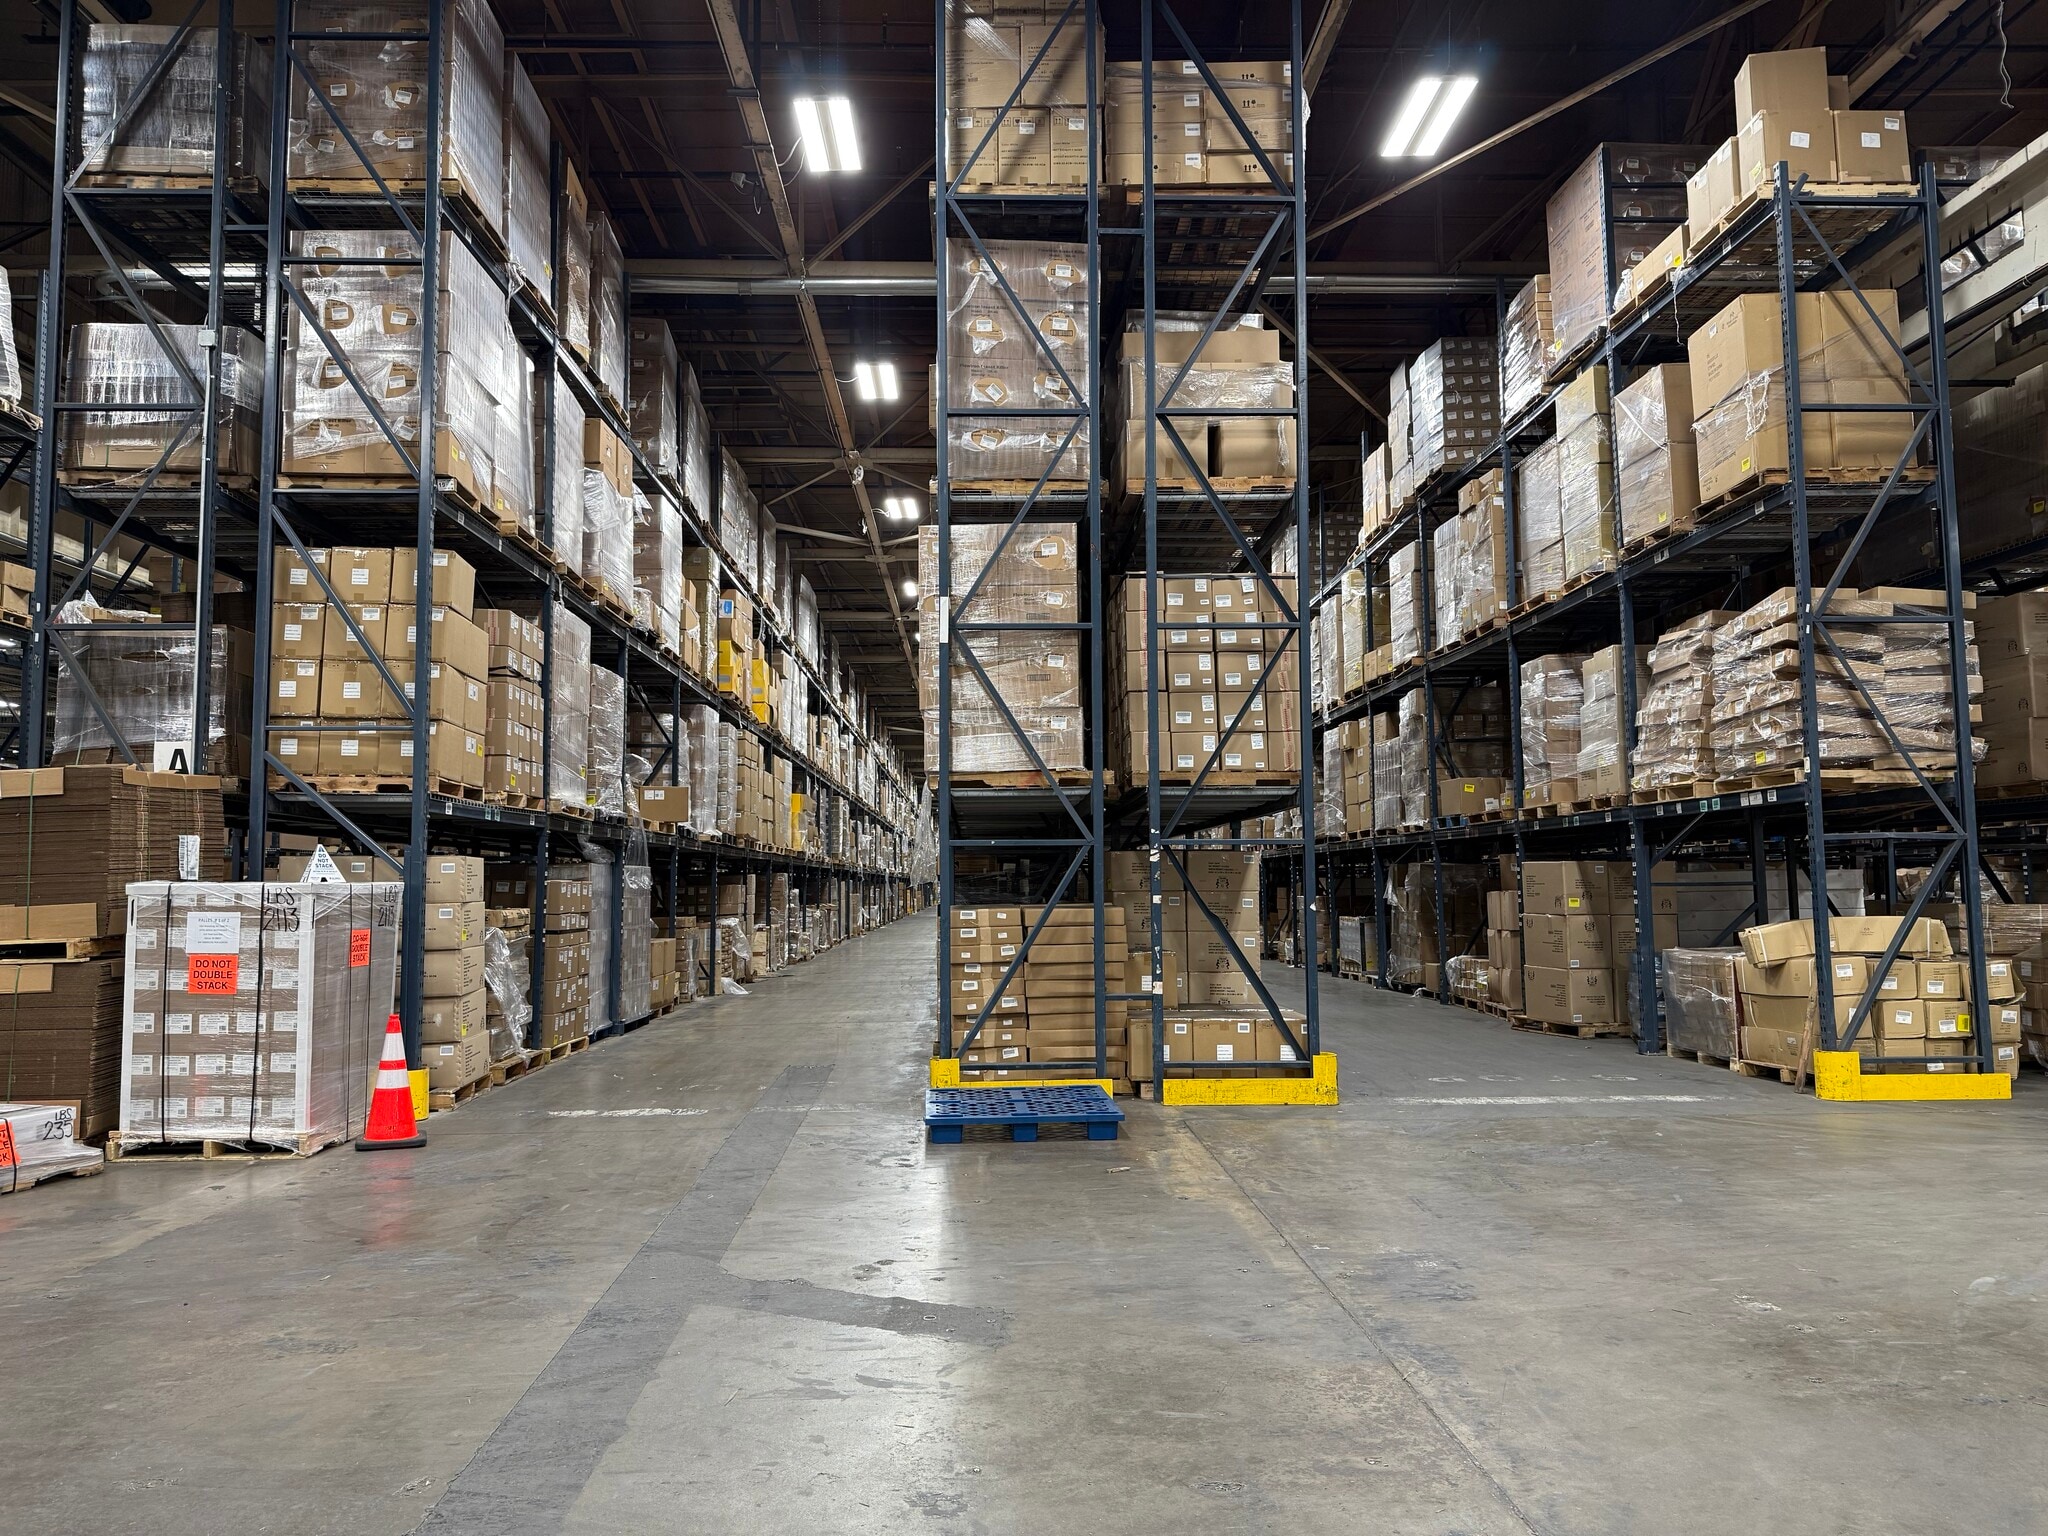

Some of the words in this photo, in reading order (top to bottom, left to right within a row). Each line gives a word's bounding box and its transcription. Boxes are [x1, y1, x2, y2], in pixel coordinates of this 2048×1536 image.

[169, 748, 190, 775] A
[266, 887, 295, 905] LBS
[262, 907, 300, 932] 2113
[195, 960, 210, 968] DO
[212, 960, 232, 968] NOT
[193, 970, 233, 979] DOUBLE
[197, 981, 228, 989] STACK
[55, 1108, 73, 1121] LBS
[43, 1120, 74, 1140] 235
